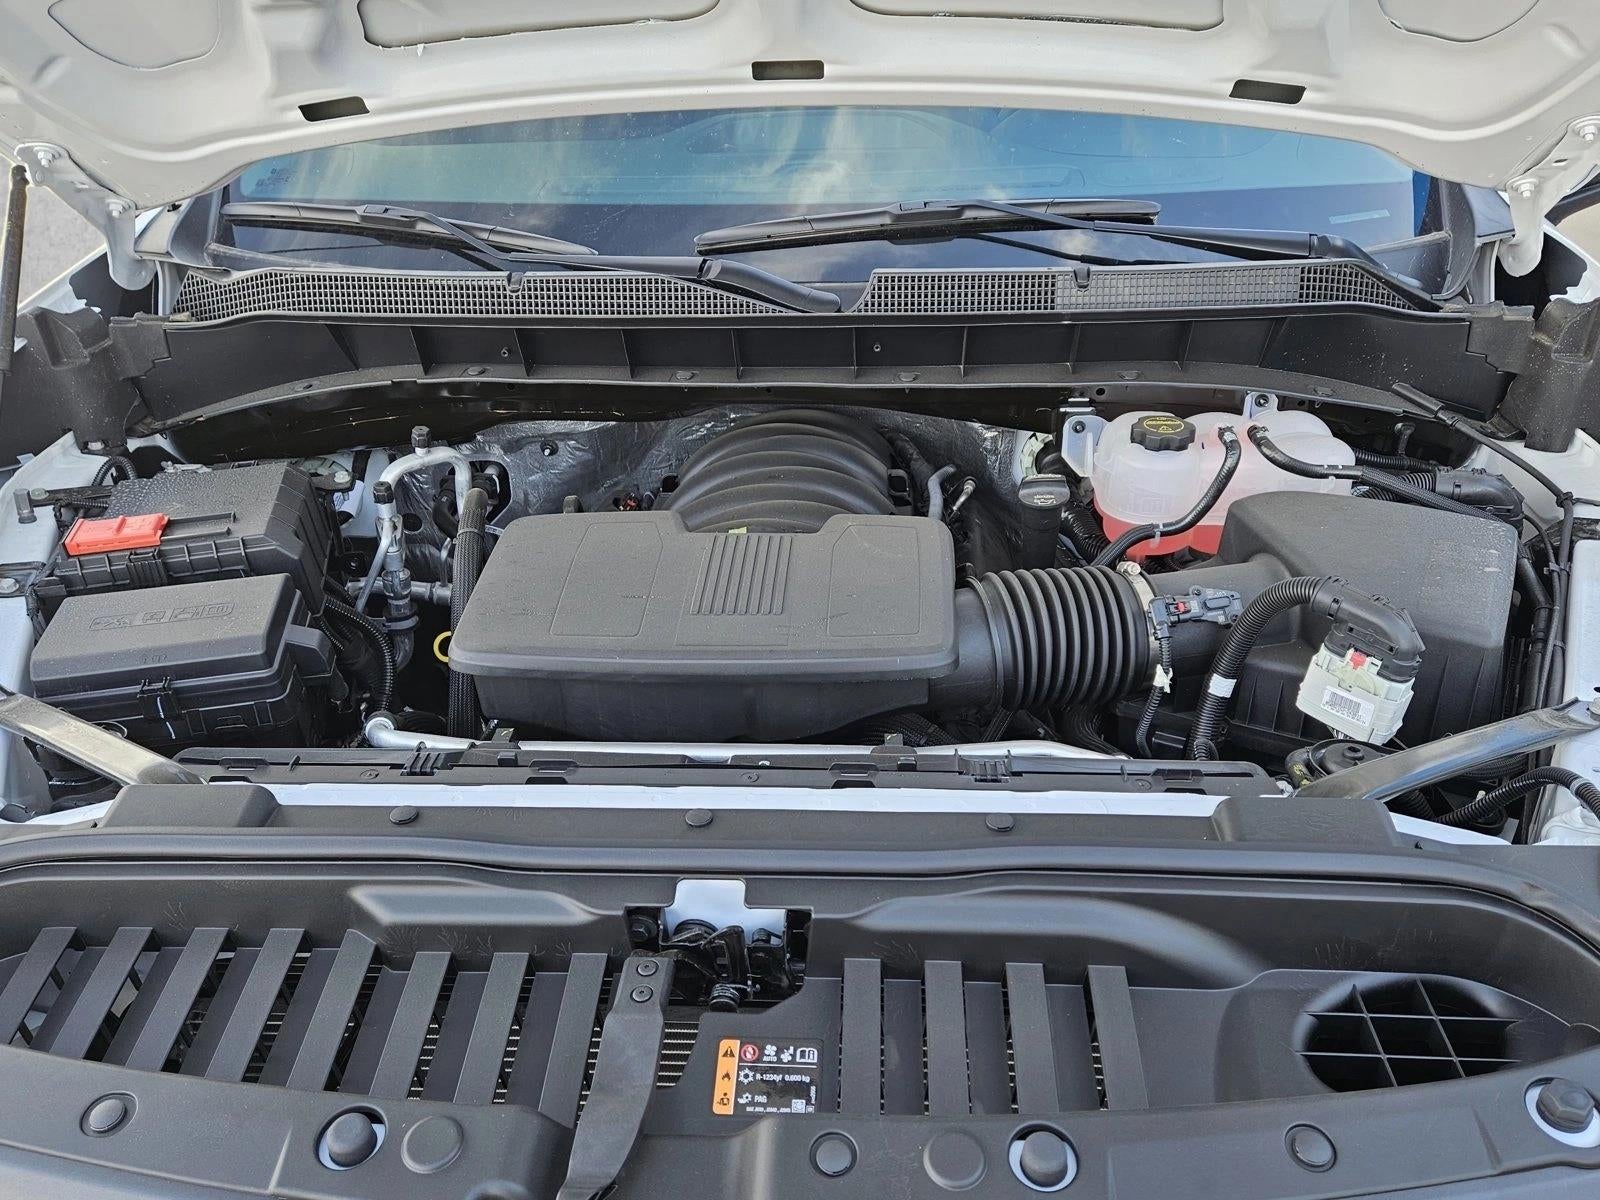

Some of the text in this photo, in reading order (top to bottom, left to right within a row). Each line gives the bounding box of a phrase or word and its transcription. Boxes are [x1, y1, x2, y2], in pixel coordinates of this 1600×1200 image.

[756, 1073, 782, 1082] R-1234yf
[802, 1075, 810, 1083] kg
[754, 1095, 767, 1103] PAG
